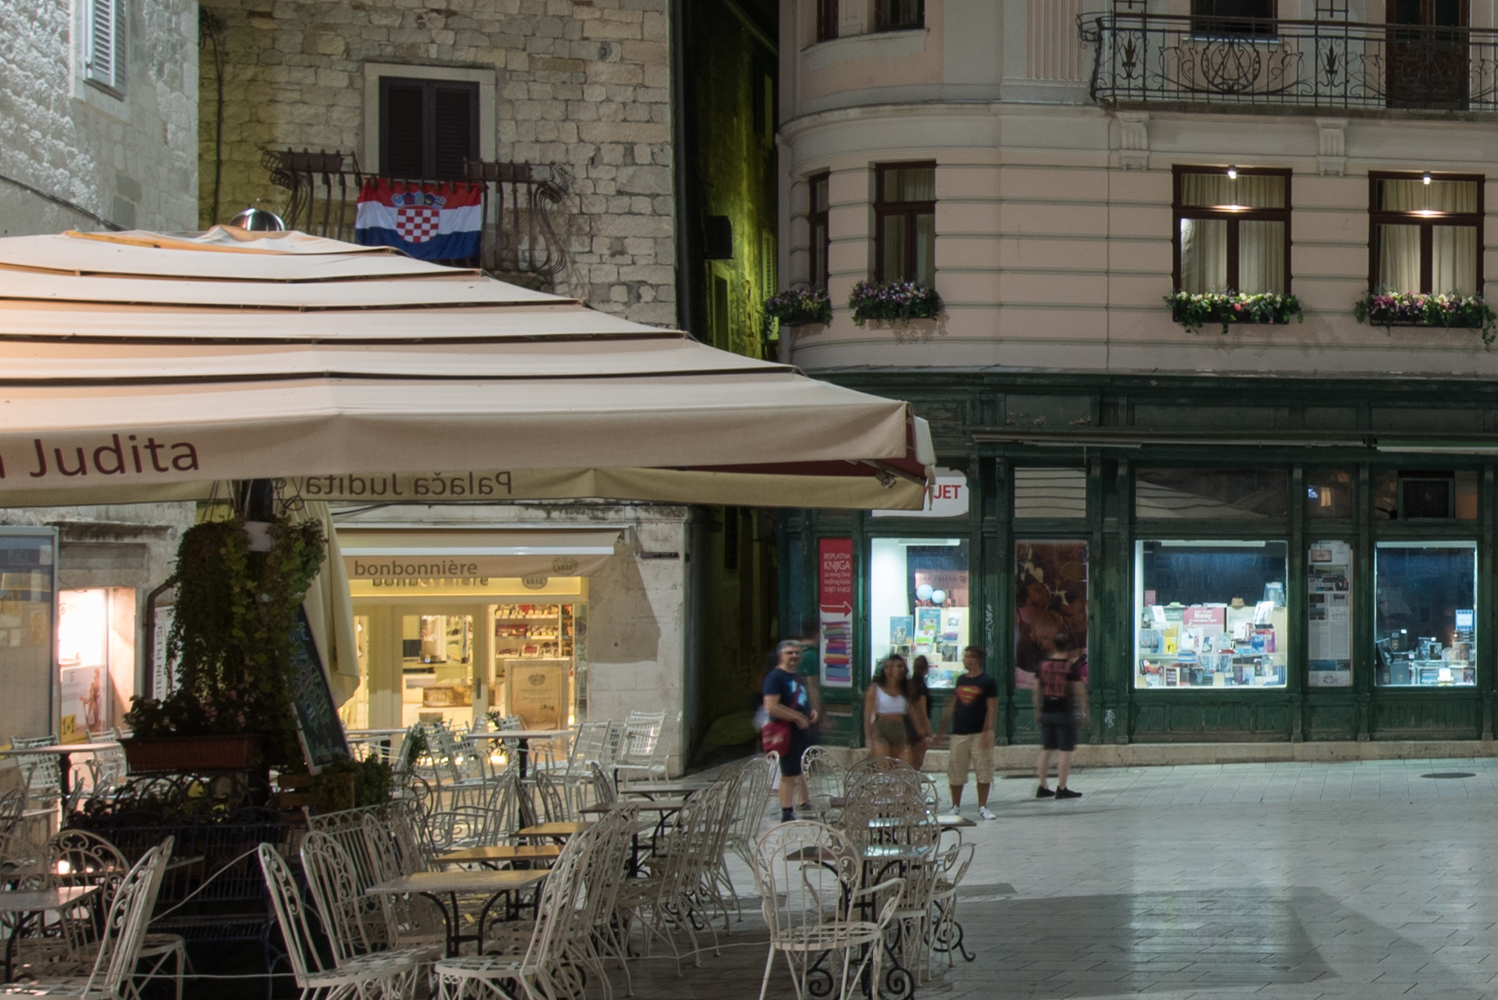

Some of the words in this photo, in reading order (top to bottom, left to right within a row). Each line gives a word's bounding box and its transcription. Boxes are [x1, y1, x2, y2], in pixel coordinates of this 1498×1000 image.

[29, 433, 200, 478] Judita
[354, 560, 478, 576] bonbonnière
[823, 561, 851, 572] KNJIGA
